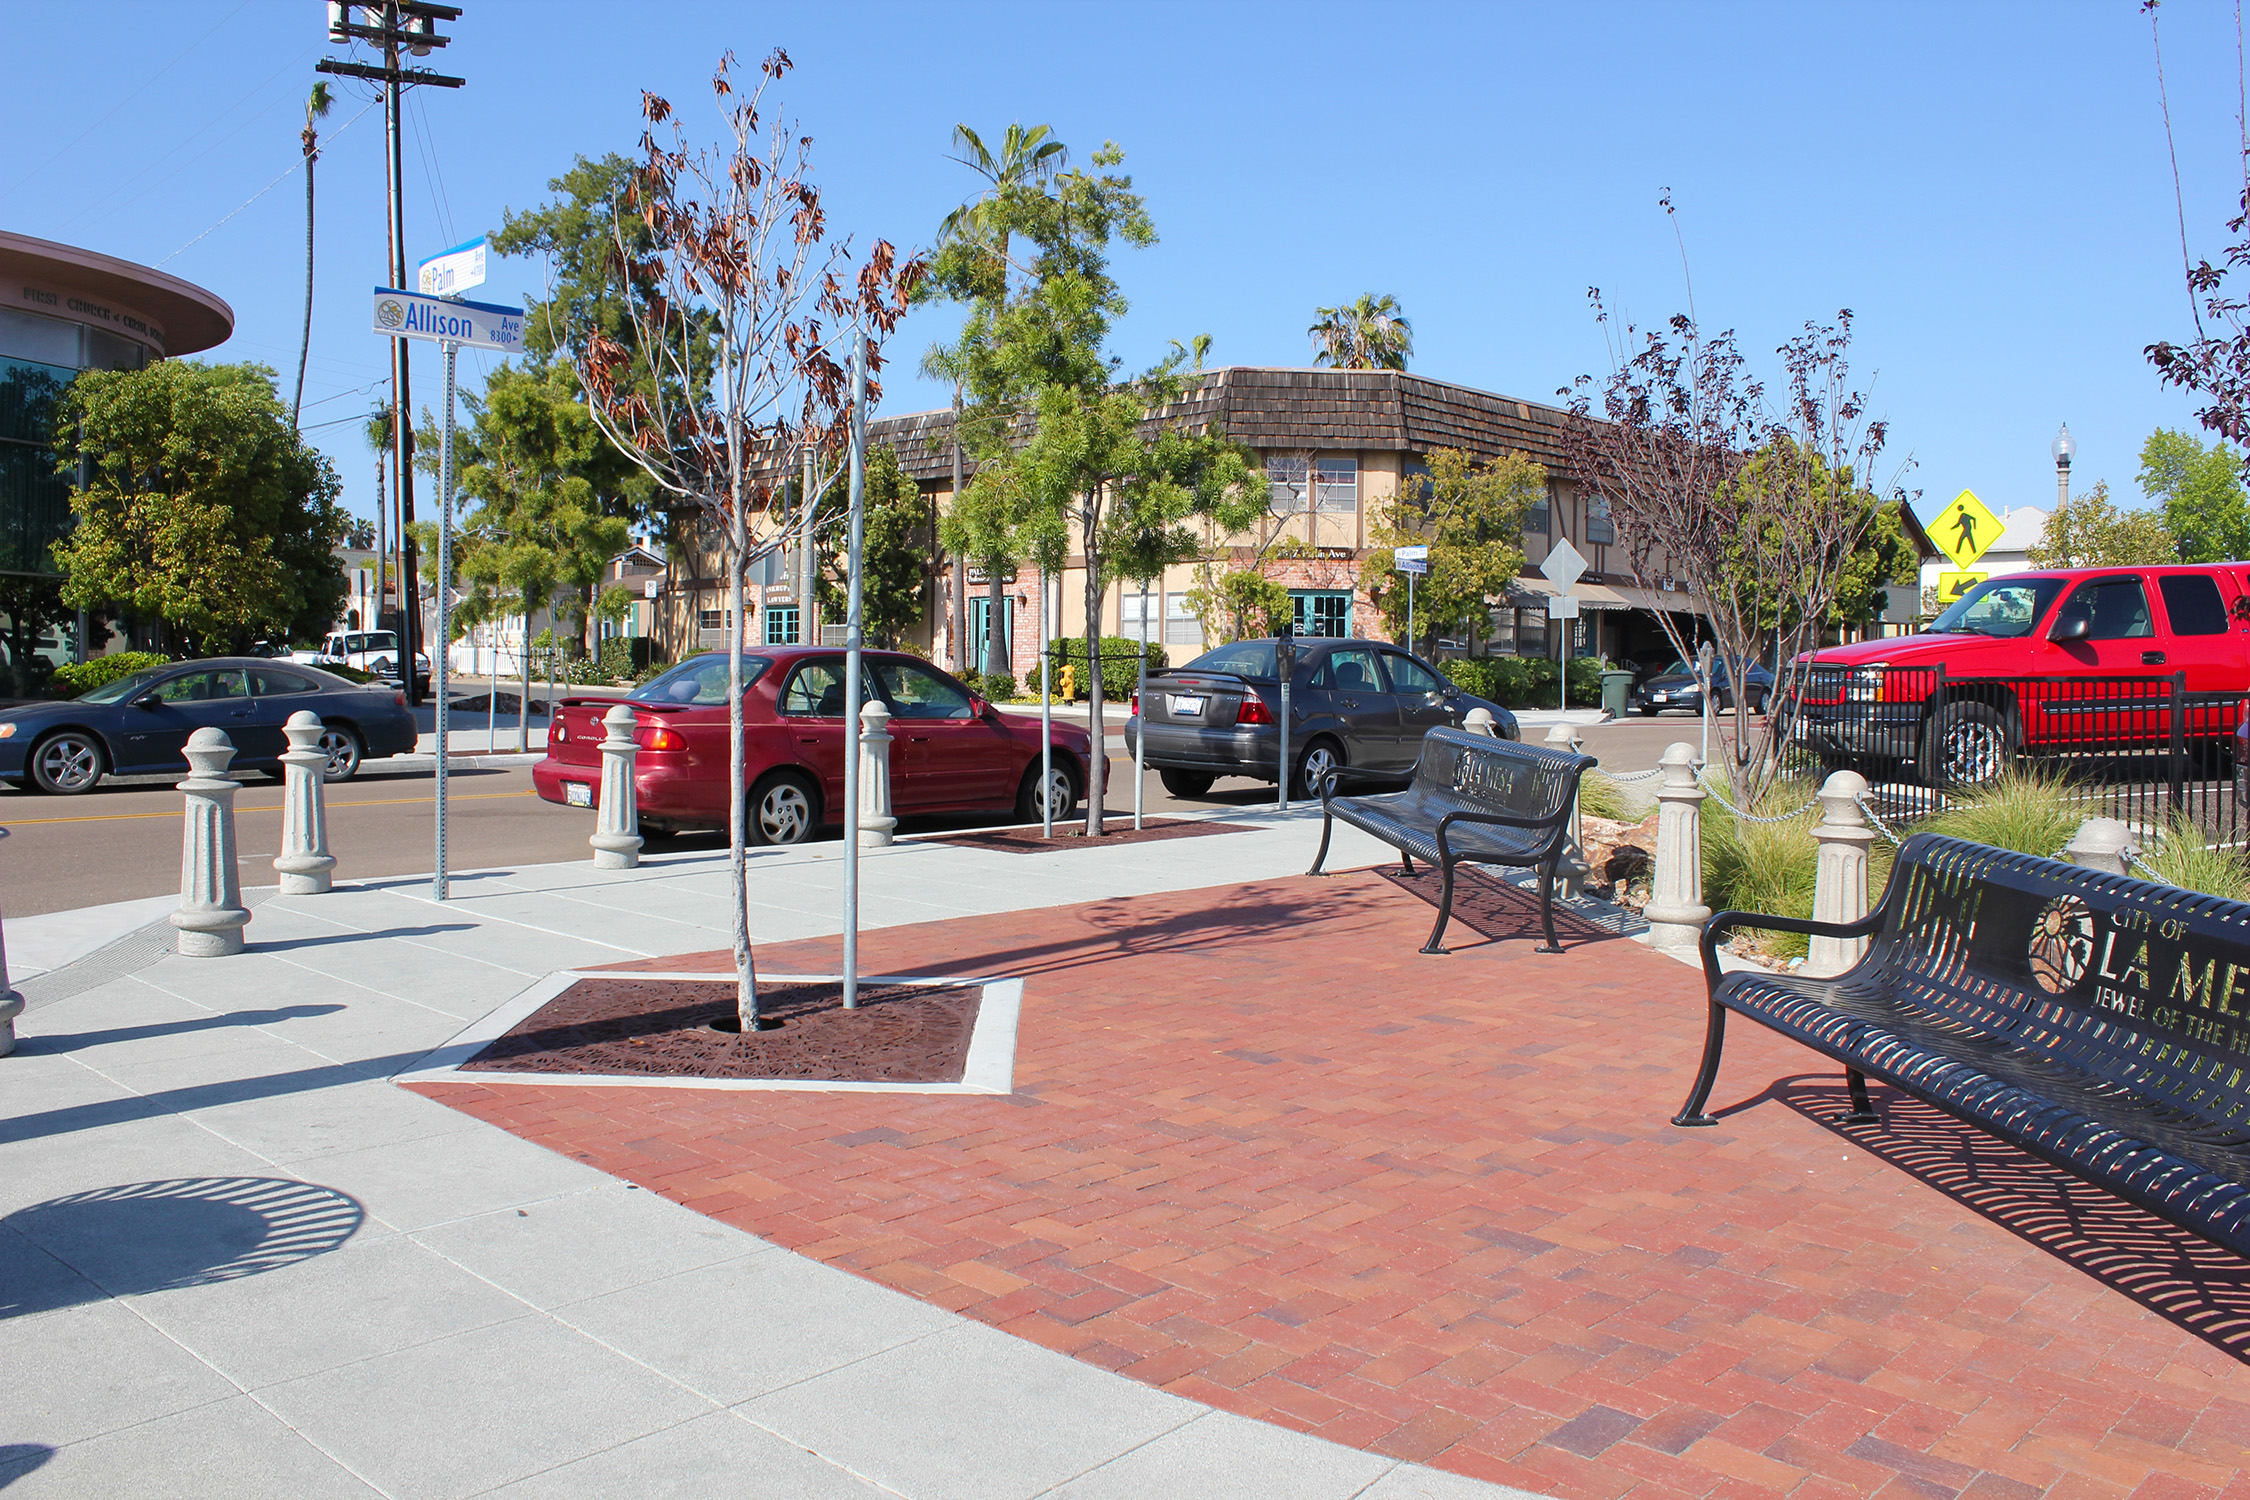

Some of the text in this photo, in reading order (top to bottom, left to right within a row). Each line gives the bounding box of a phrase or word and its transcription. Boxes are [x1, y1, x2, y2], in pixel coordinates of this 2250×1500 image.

[475, 250, 484, 263] Ave
[432, 263, 454, 293] Palm
[23, 287, 58, 307] FIRST
[67, 297, 110, 321] CHURCH
[405, 302, 472, 338] Allison
[501, 316, 519, 332] Ave
[490, 329, 512, 344] 8300
[1328, 548, 1346, 558] Ave
[1401, 549, 1418, 557] Palm
[1401, 561, 1420, 570] Allison
[2111, 905, 2190, 941] CITY OF
[2098, 930, 2250, 1022] LA ME
[2091, 986, 2146, 1020] JEWEL
[2152, 1005, 2182, 1030] OF
[2185, 1014, 2226, 1046] THE
